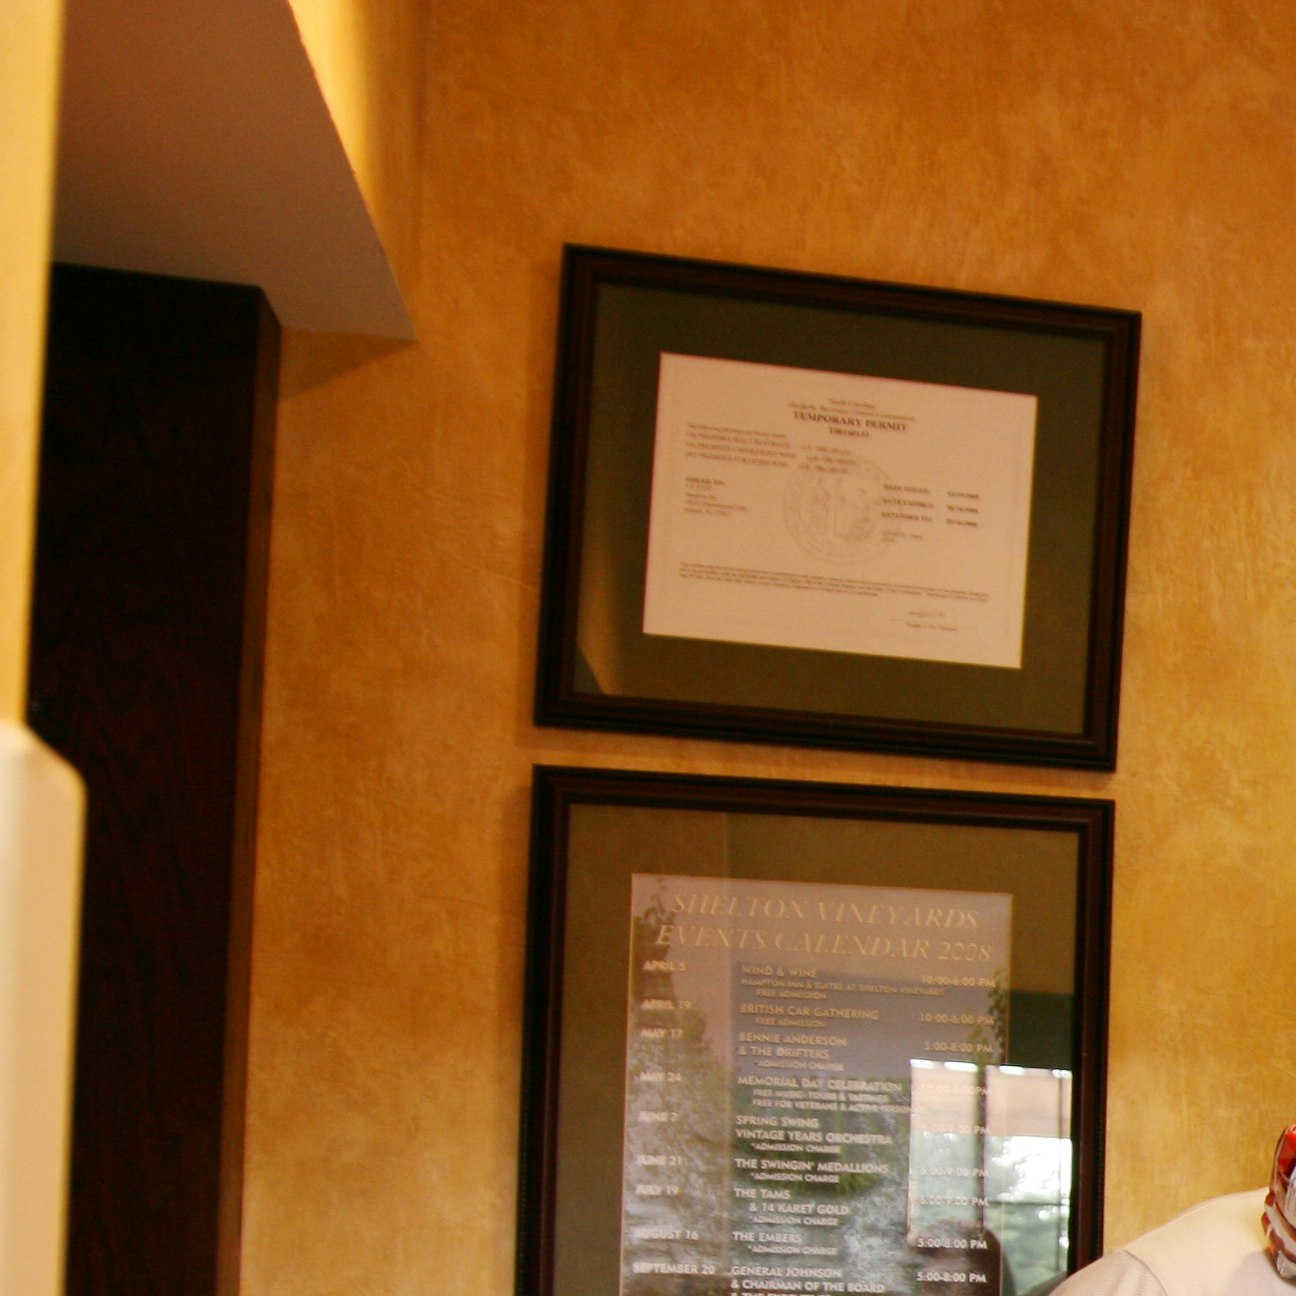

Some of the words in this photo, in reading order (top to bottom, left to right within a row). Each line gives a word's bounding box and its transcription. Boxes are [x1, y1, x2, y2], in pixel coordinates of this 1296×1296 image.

[865, 420, 908, 432] PERMIT
[672, 894, 809, 919] SHELTON
[818, 902, 980, 929] VINEYARDS
[656, 924, 768, 949] EVENTS
[775, 932, 930, 960] CALENDAR
[740, 1004, 784, 1014] BRITISH
[788, 1005, 811, 1016] CAR
[814, 1008, 879, 1020] GATHERING
[736, 1115, 778, 1126] SPRING
[735, 1129, 785, 1141] VINTAGE
[787, 1130, 823, 1142] YEARS
[735, 1158, 758, 1169] THE
[734, 1187, 758, 1199] THE
[760, 1189, 791, 1200] TAMS
[762, 1202, 775, 1213] 14
[778, 1203, 814, 1214] KARET
[817, 1204, 849, 1216] GOLD
[732, 1231, 755, 1242] THE
[758, 1232, 802, 1244] EMBERS
[970, 1240, 988, 1250] PM
[632, 1262, 698, 1275] SEPTEMBER
[701, 1264, 715, 1275] 20
[731, 1265, 783, 1277] GENERAL
[786, 1267, 842, 1279] JOHNSON
[969, 1274, 987, 1284] PM
[742, 1279, 801, 1290] CHAIRMAN
[805, 1282, 821, 1292] OF
[822, 1282, 844, 1292] THE
[847, 1282, 885, 1293] BOARD
